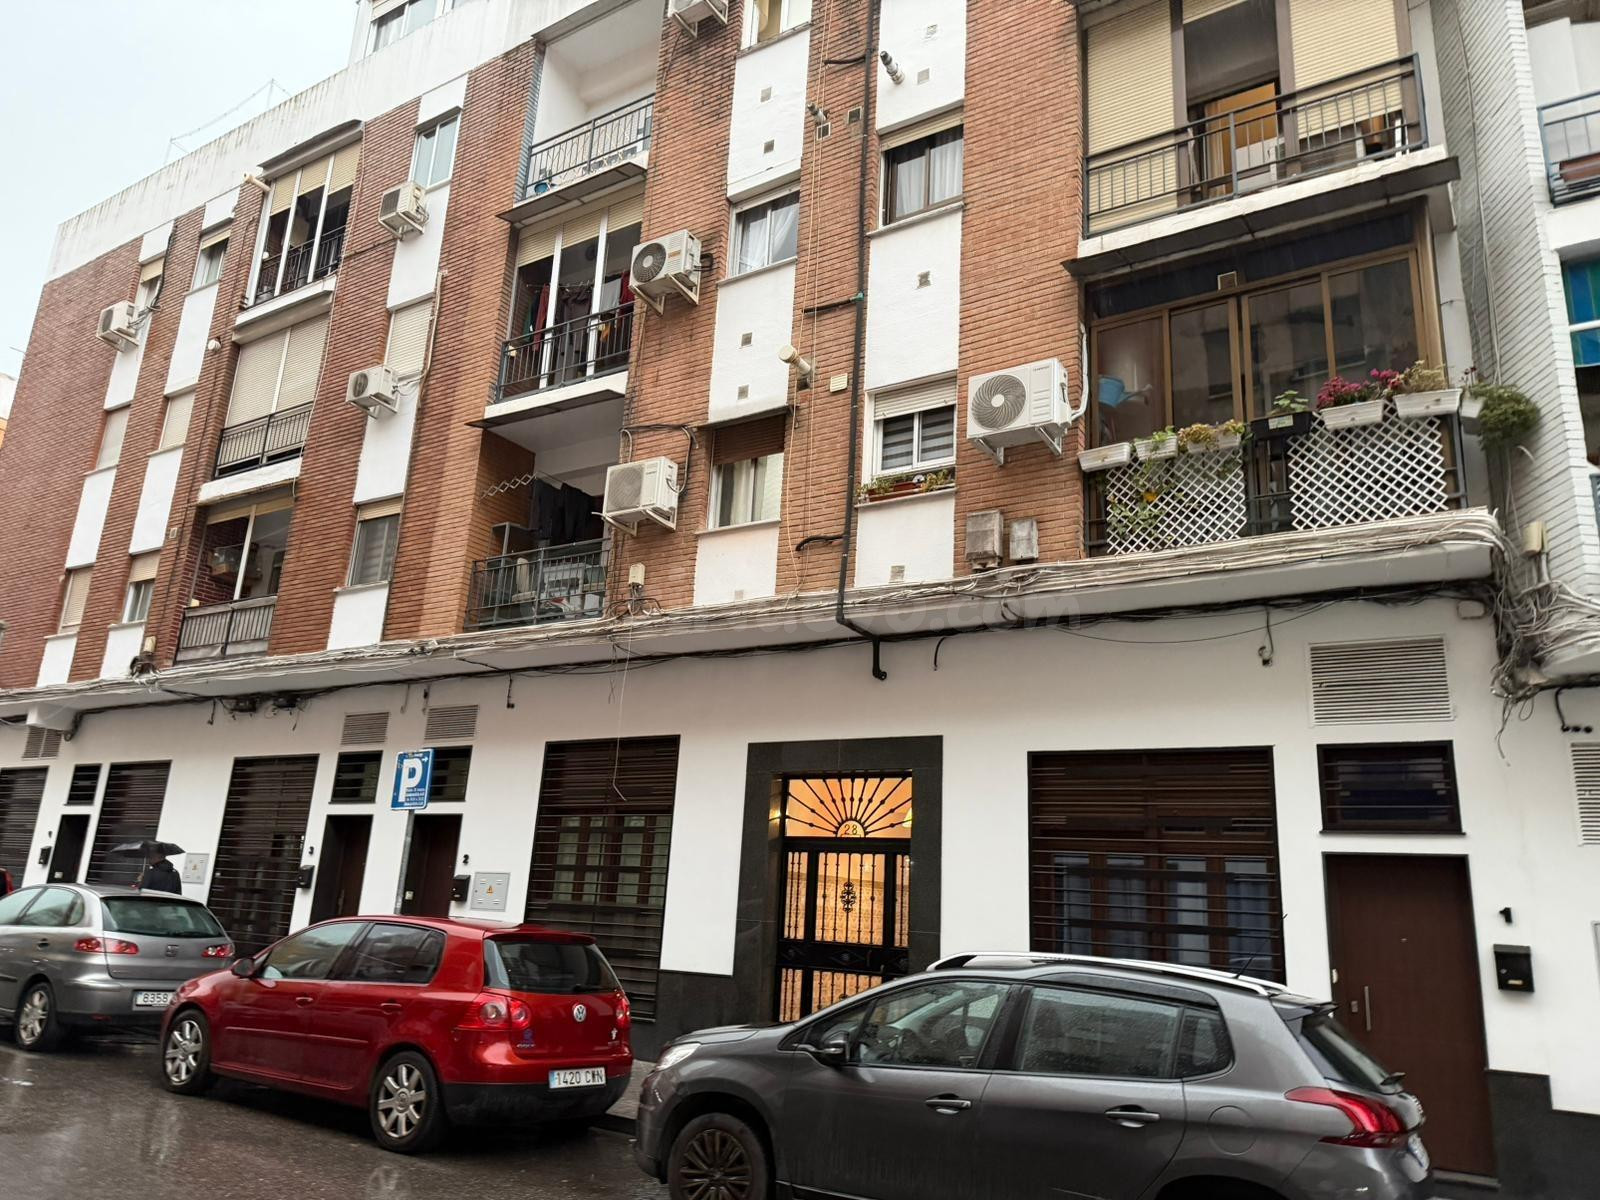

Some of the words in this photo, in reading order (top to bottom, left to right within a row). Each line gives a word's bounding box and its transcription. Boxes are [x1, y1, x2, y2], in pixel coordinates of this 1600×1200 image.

[398, 757, 423, 803] P
[844, 823, 858, 836] 28
[462, 854, 470, 864] 2
[1499, 906, 1513, 924] 1
[556, 1071, 582, 1086] 1420
